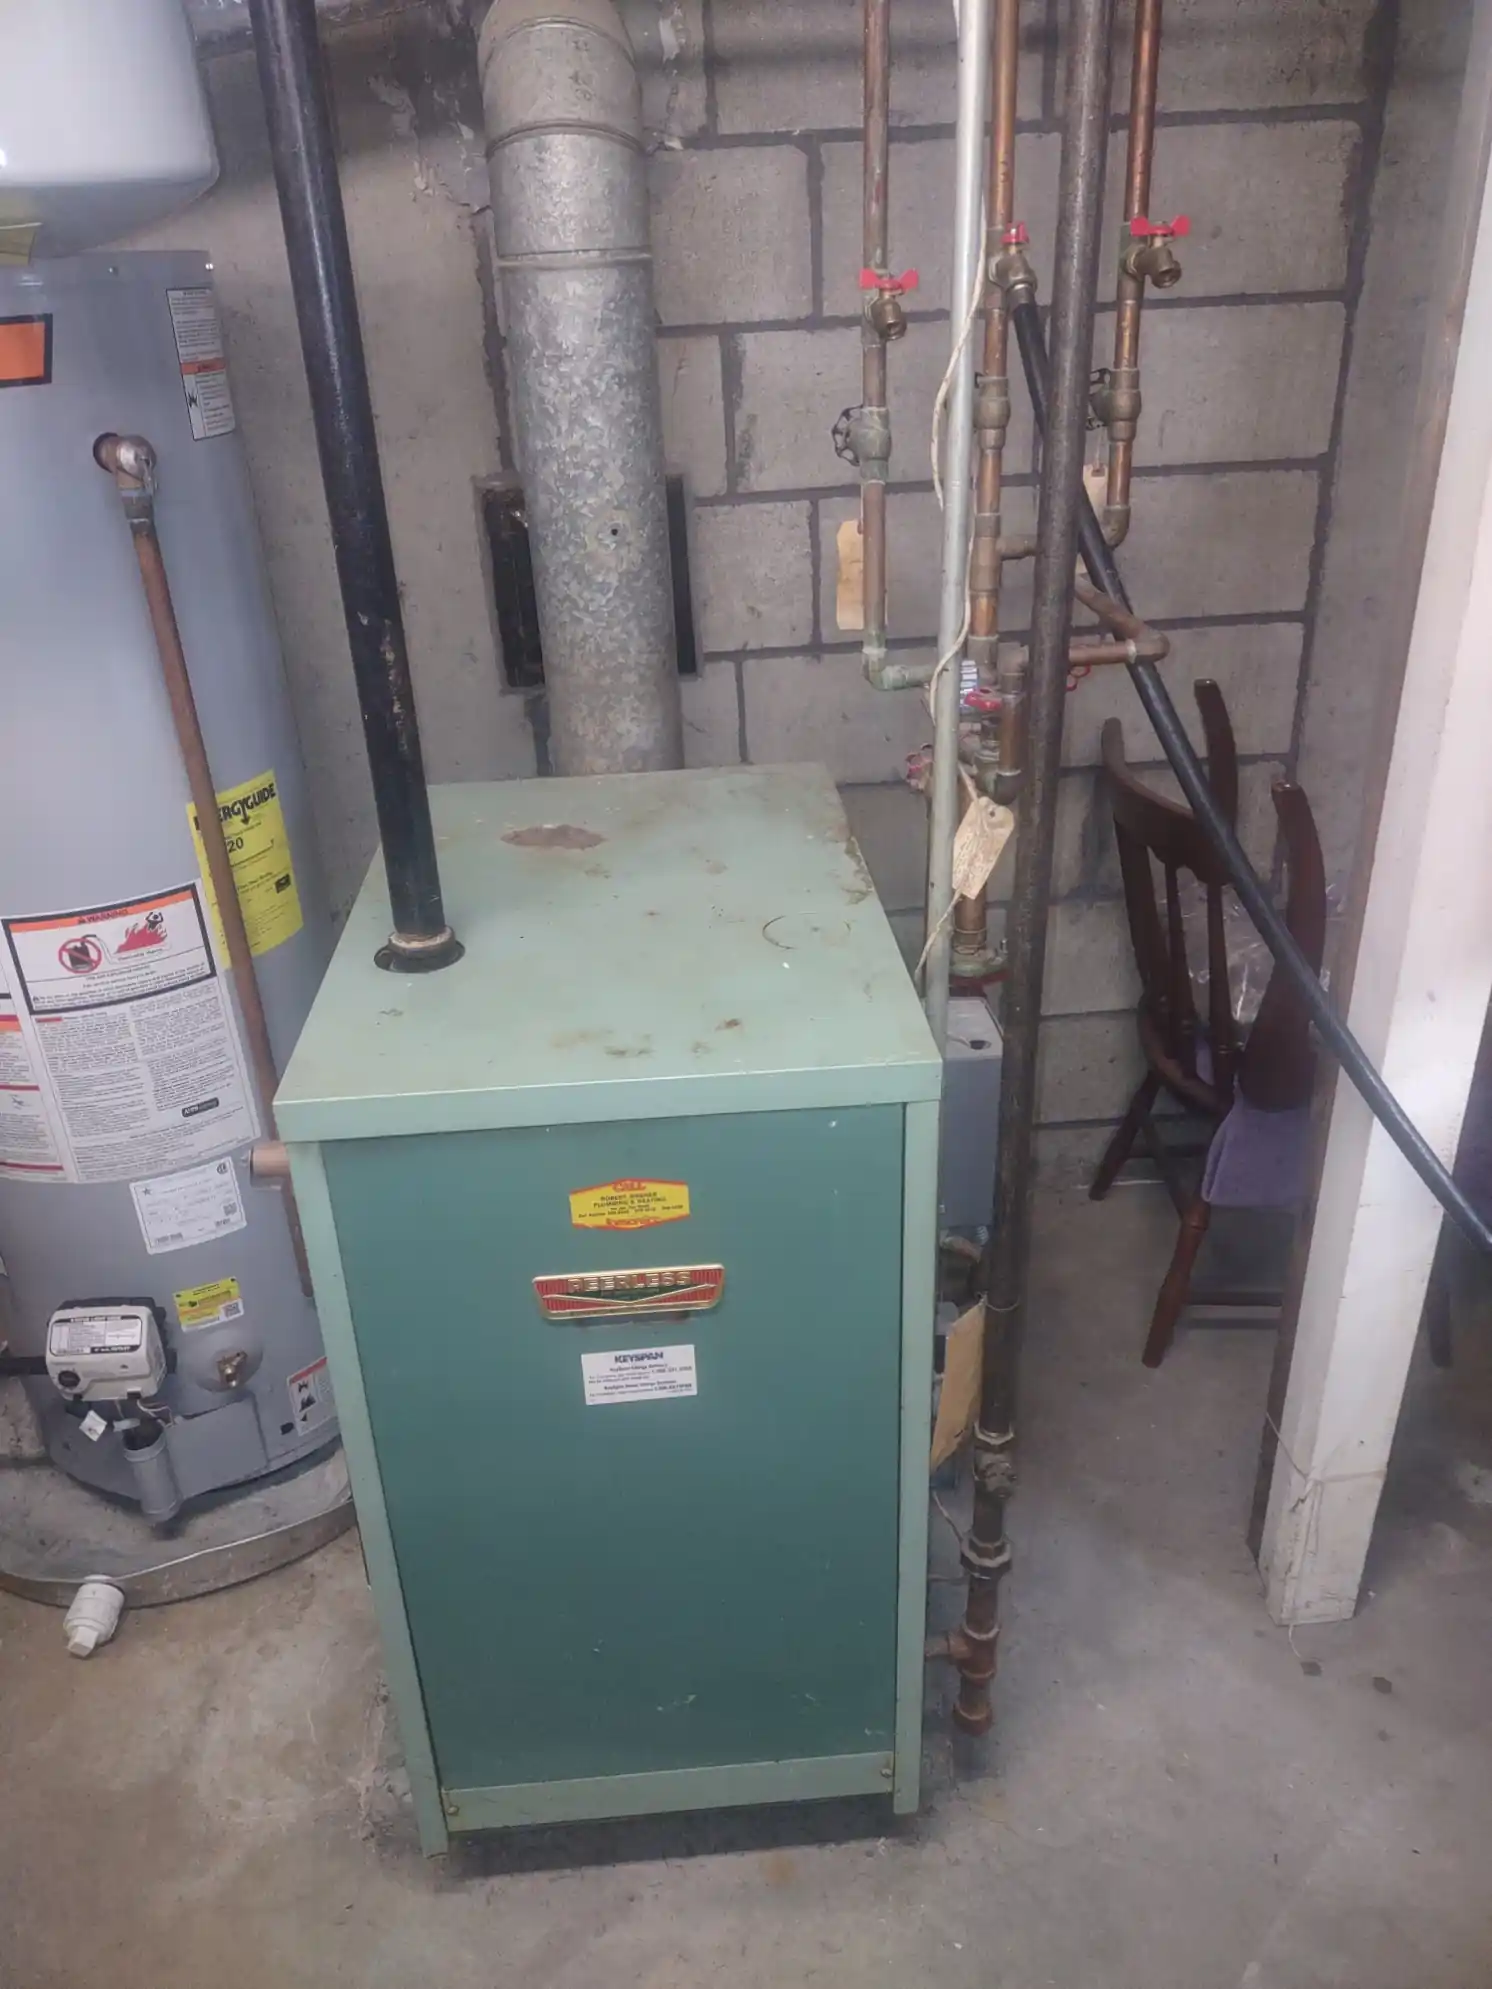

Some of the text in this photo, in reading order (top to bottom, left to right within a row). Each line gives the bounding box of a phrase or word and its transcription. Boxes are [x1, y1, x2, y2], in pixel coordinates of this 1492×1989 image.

[86, 908, 128, 922] WARNING
[594, 1200, 629, 1208] PLUMBING
[637, 1196, 667, 1204] HEATING
[568, 1271, 691, 1293] PEERLESS
[614, 1351, 664, 1363] KEYSPAN
